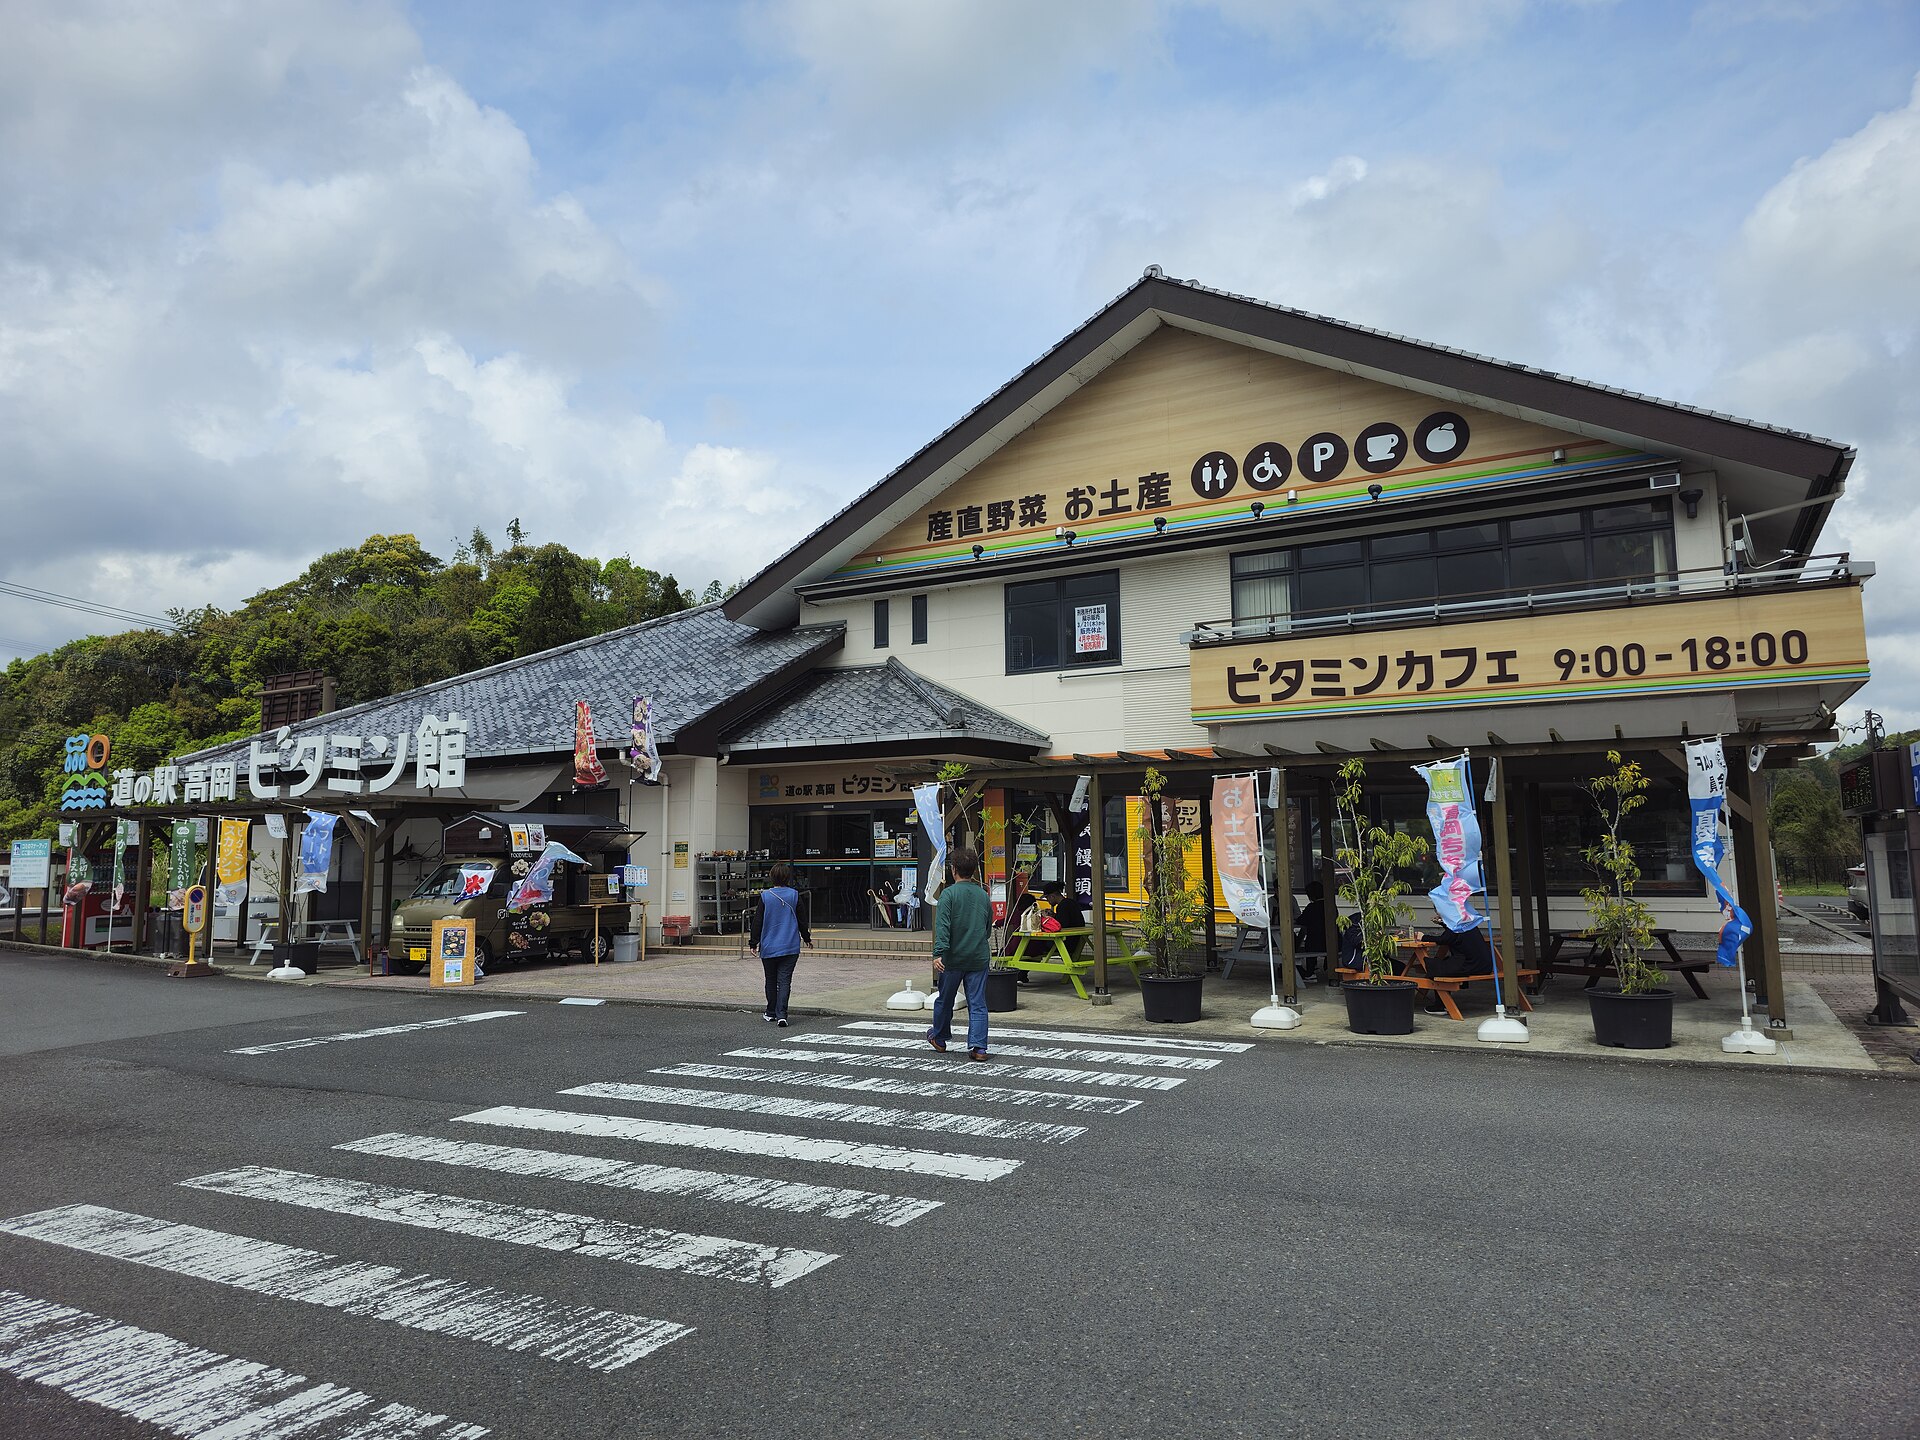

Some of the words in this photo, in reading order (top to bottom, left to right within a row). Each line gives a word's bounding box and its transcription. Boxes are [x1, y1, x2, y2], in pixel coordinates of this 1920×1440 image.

[1313, 441, 1335, 473] P
[926, 494, 1048, 542] 産直野菜
[1065, 472, 1172, 521] お土産
[1226, 647, 1519, 704] ビタミンカフェ
[110, 766, 179, 807] 道の駅
[183, 761, 238, 804] 高岡
[249, 712, 471, 799] ビタミン館
[785, 784, 813, 797] 道の駅
[815, 783, 836, 796] 高岡
[1176, 806, 1197, 816] タミン
[318, 816, 333, 855] ソフト
[1179, 817, 1193, 825] フェ
[222, 825, 235, 878] スカッシュ
[234, 825, 246, 873] ビタミン
